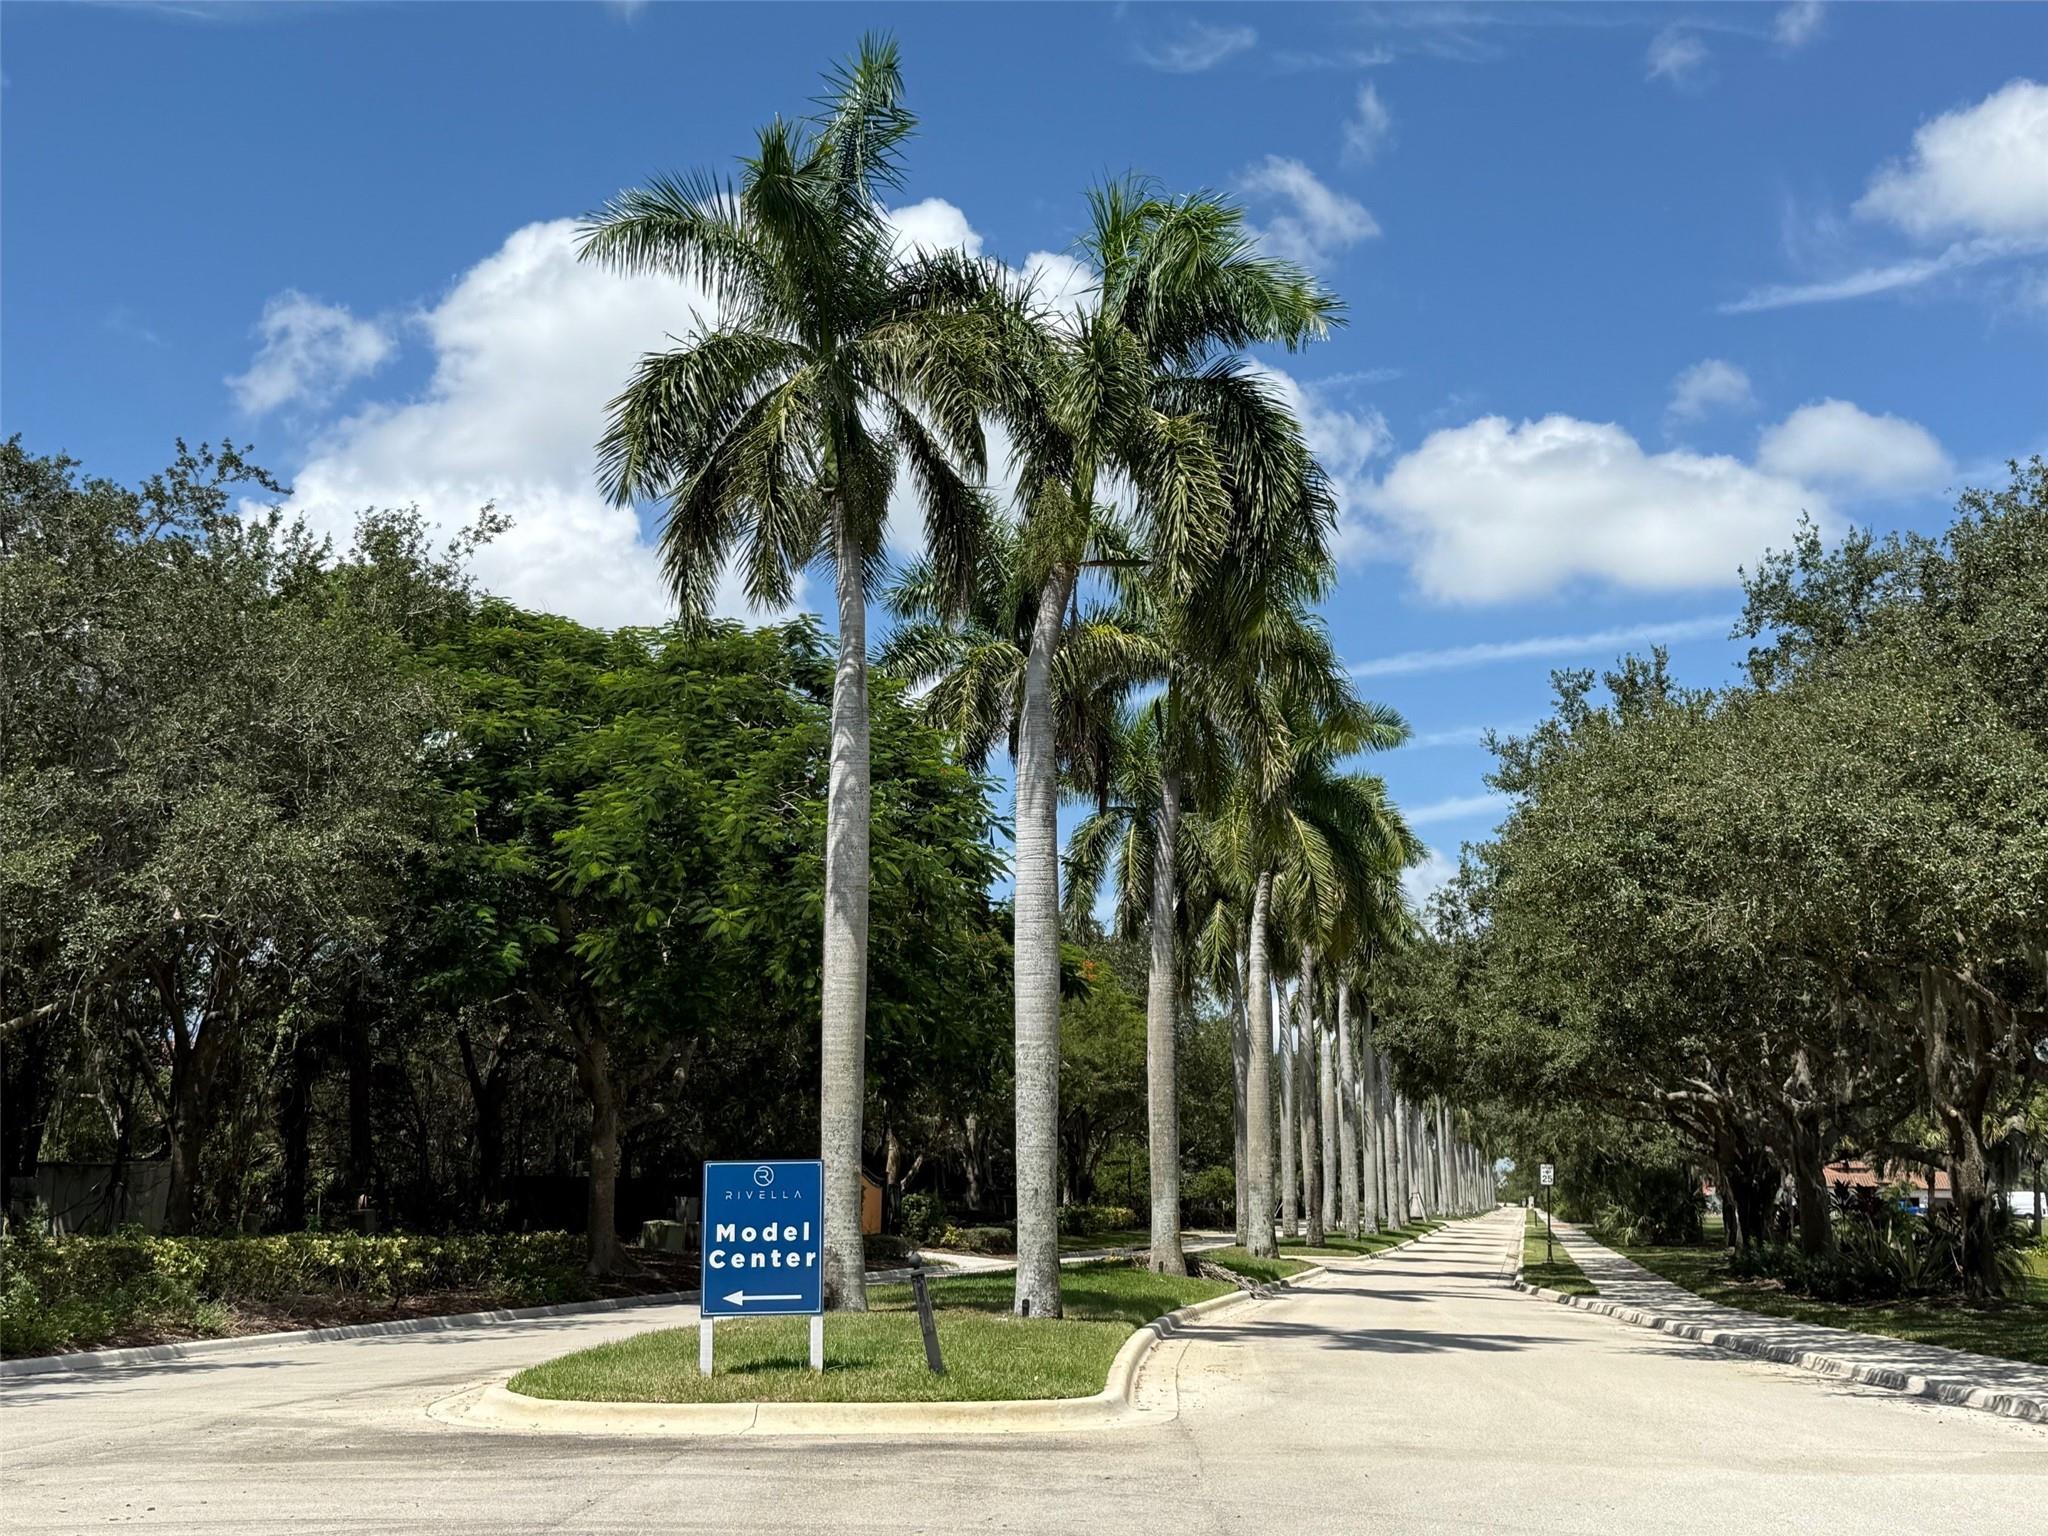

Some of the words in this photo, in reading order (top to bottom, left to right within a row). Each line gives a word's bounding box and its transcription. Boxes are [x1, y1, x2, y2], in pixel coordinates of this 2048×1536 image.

[1542, 1175, 1552, 1183] 25
[725, 1190, 802, 1200] RIVELLA
[716, 1222, 810, 1242] Model
[709, 1249, 816, 1269] Center
